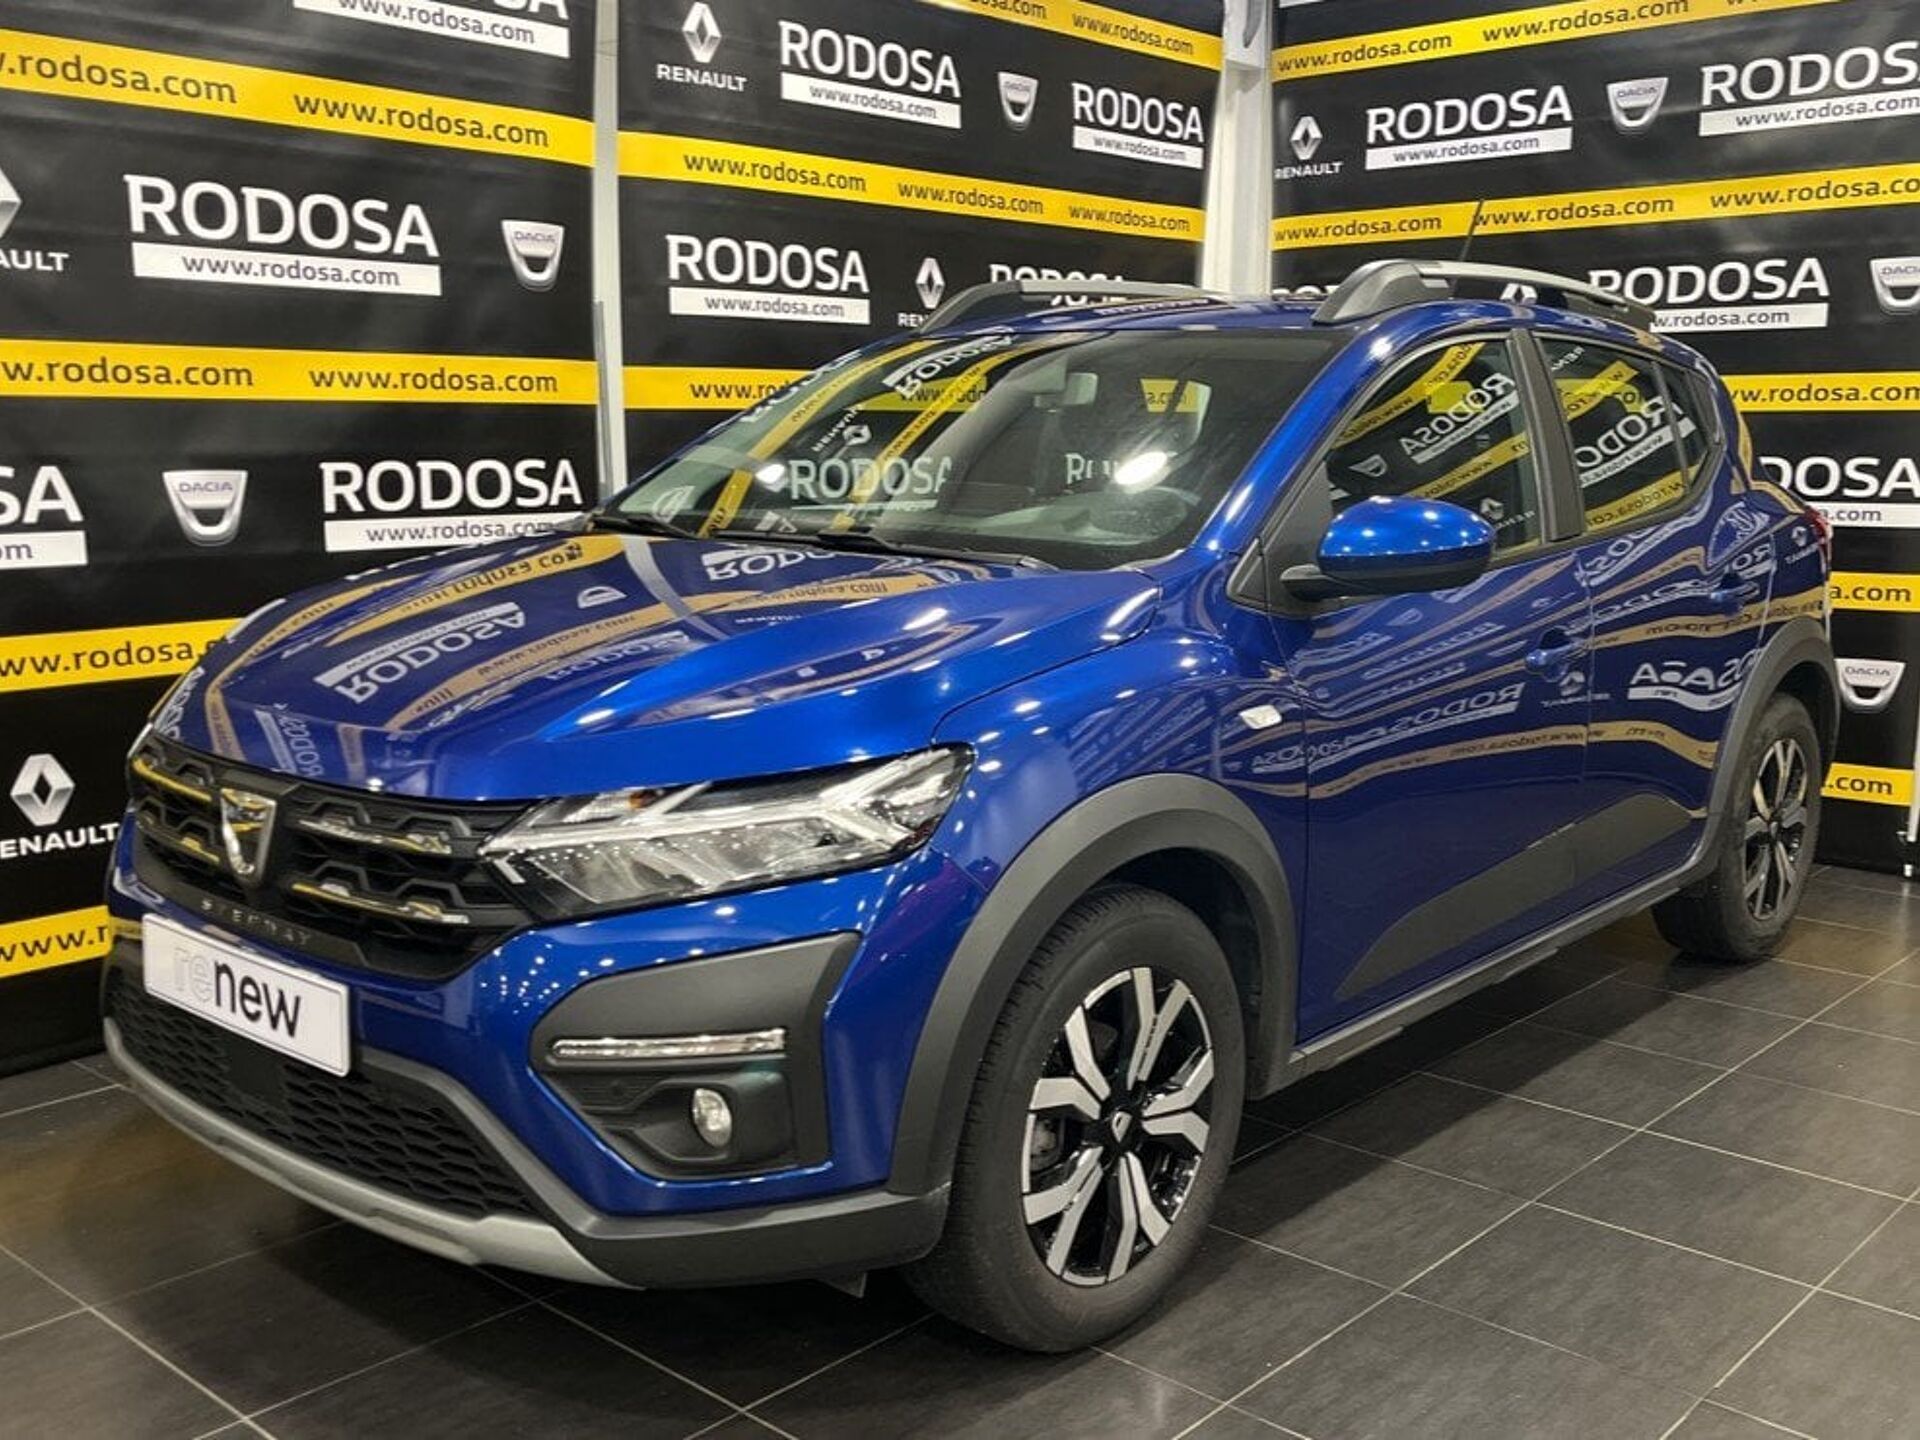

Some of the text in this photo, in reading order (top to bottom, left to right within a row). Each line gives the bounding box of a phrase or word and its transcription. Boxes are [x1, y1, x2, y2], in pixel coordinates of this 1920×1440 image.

[1072, 13, 1194, 55] www.rodosa.com
[1278, 0, 1689, 72] www.rodosa.com www.rodosa.com
[779, 20, 961, 98] RODOSA
[656, 64, 747, 92] RENAULT
[809, 84, 937, 119] www.rodosa.com
[1072, 82, 1205, 143] RODOSA
[1366, 85, 1573, 144] RODOSA
[294, 94, 548, 147] www.rodosa.com
[1093, 137, 1185, 161] www.rodosa.com
[1393, 136, 1539, 162] www.rodosa.com
[1275, 161, 1343, 179] RENAULT
[683, 154, 1190, 232] www.rodosa.com www.rodosa.com www.rodosa.com
[123, 174, 440, 257] RODOSA
[1274, 216, 1441, 241] www.rodosa.com
[514, 231, 555, 244] DACIA
[181, 255, 400, 286] www.rodosa.com
[665, 234, 869, 293] RODOSA
[704, 295, 844, 317] www.rodosa.com
[1, 356, 558, 392] w.rodosa.com www.rodosa.com
[178, 481, 233, 493] DACIA
[319, 459, 583, 513] RODOSA
[1845, 666, 1891, 676] DACIA
